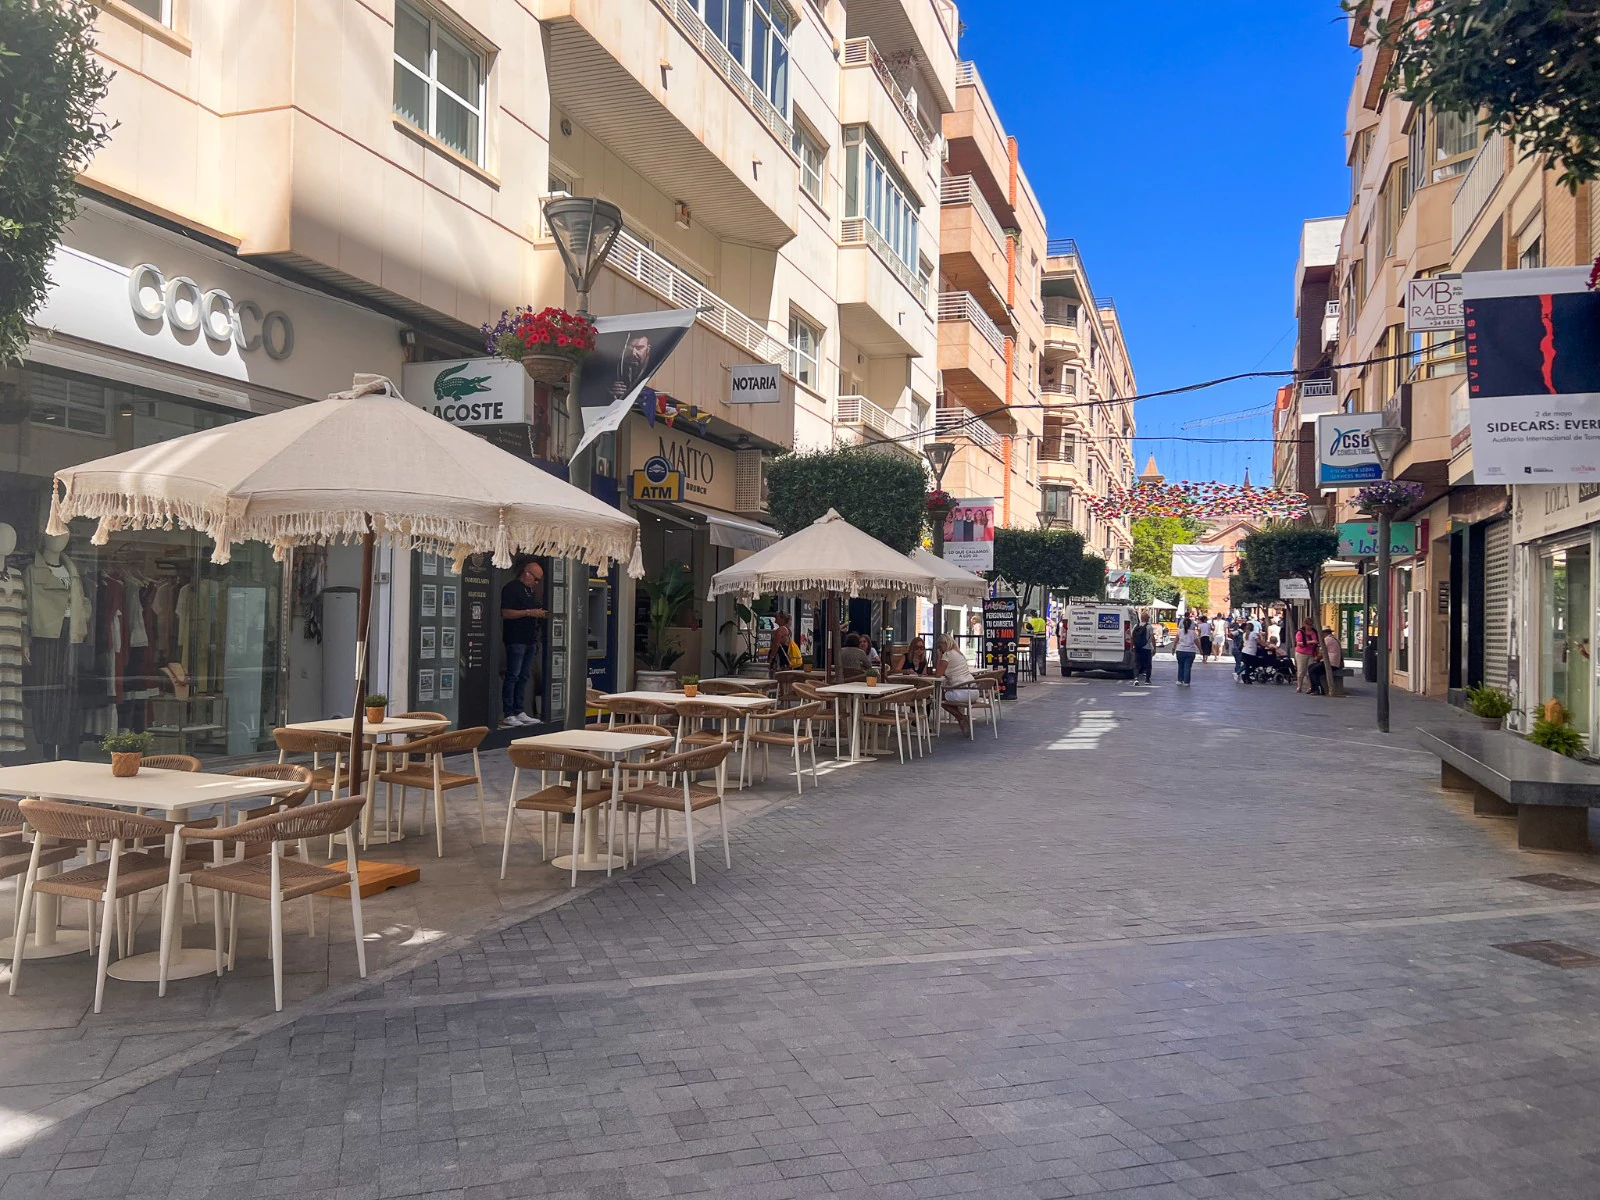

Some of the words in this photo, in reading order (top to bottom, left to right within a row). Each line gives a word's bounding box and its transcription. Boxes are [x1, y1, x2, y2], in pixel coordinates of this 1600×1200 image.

[1412, 281, 1452, 304] MB
[129, 264, 294, 360] COCCO
[1467, 307, 1480, 392] EVEREST
[733, 376, 776, 391] NOTARIA
[422, 402, 503, 422] ACOSTE
[1487, 420, 1560, 433] SIDECARS:
[1343, 434, 1370, 448] CSB
[1492, 435, 1524, 443] Auditorio
[1526, 433, 1572, 441] Internacional
[659, 436, 713, 484] MAÍTO
[641, 486, 672, 499] ATM
[685, 482, 708, 495] BRUNCH
[992, 620, 1014, 628] CAMISETA
[986, 629, 996, 639] EN
[996, 629, 1001, 638] 5
[1001, 628, 1015, 638] MIN
